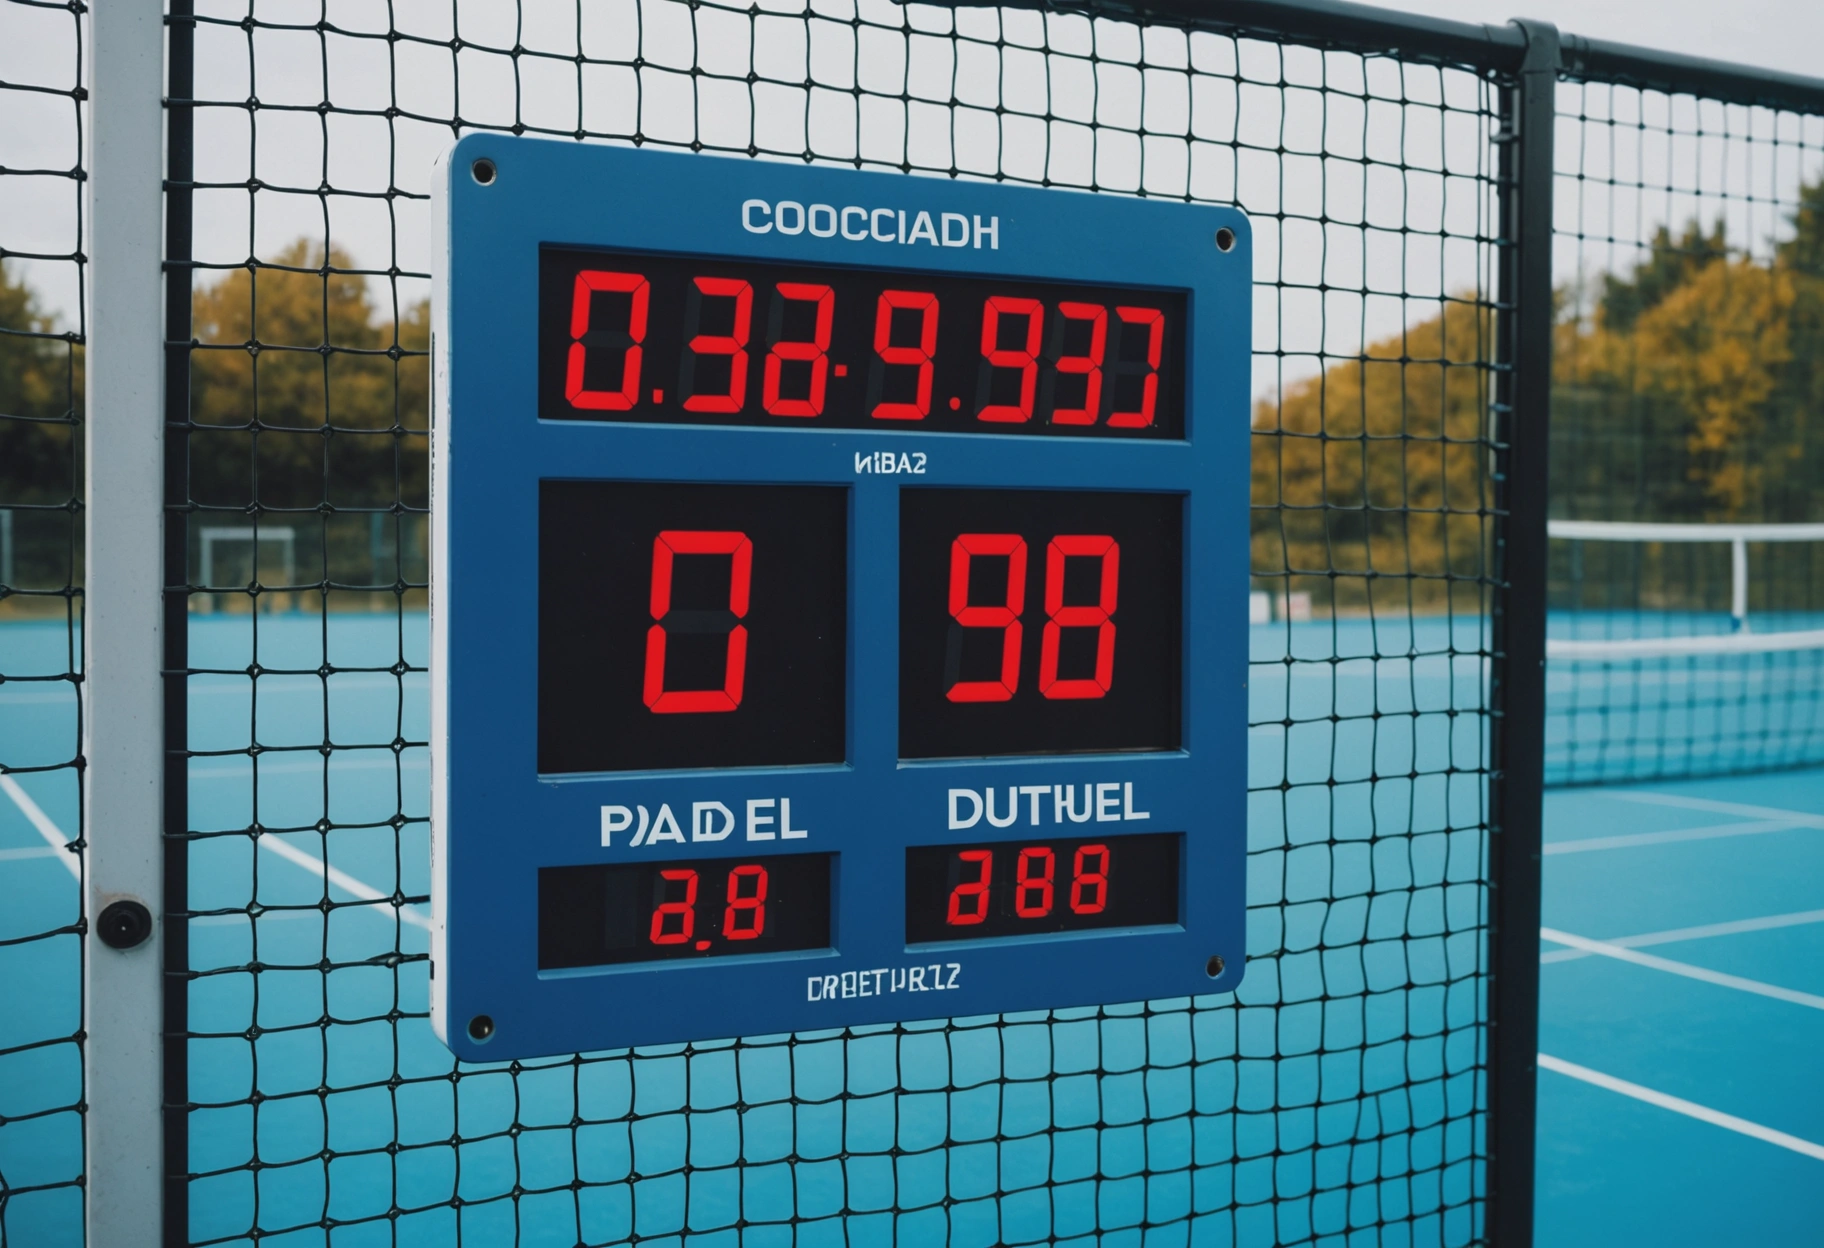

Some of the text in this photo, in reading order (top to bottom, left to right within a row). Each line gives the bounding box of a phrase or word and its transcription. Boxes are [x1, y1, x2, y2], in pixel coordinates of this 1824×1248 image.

[742, 199, 999, 250] COOCCIADH
[644, 530, 753, 714] 0
[947, 533, 1120, 702] 98
